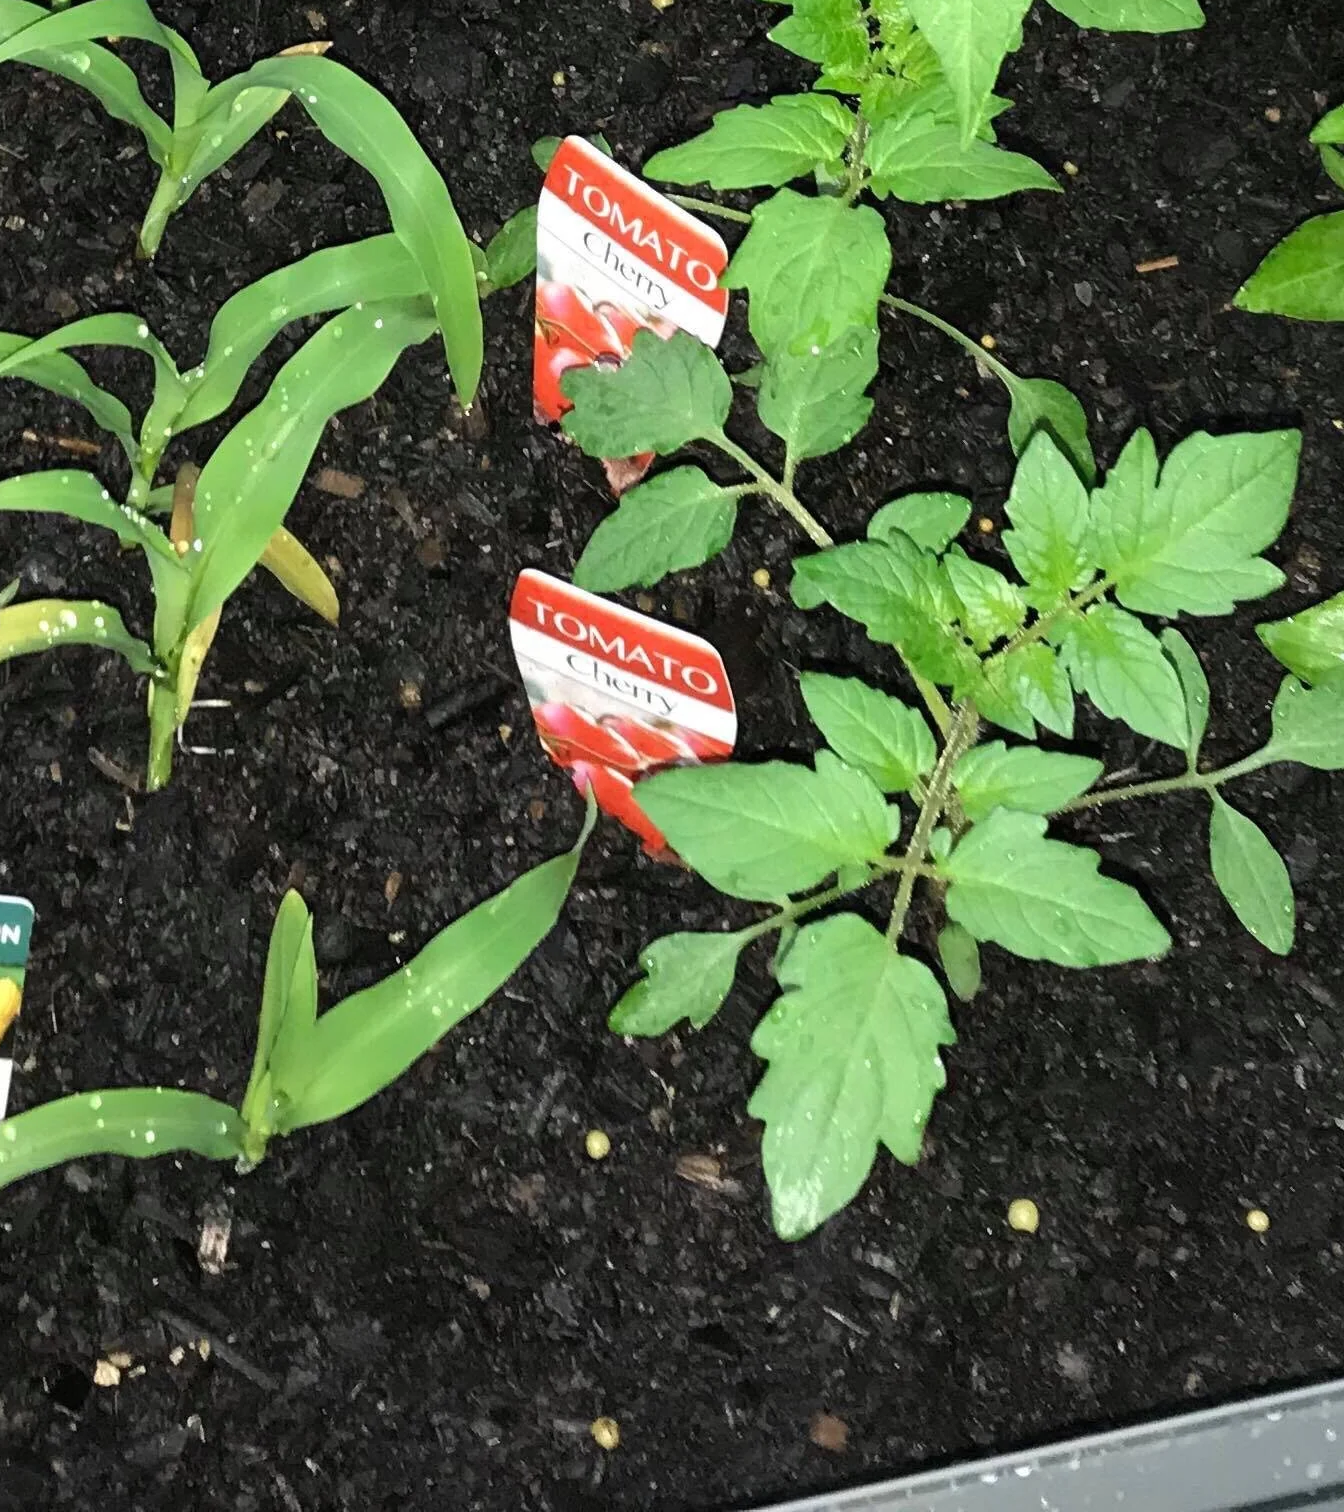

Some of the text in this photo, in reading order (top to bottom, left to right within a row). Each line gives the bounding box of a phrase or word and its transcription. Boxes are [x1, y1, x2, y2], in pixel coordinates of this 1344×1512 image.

[563, 164, 718, 292] TOMATO
[582, 231, 674, 310] Cherry
[526, 596, 718, 695] TOMATO
[566, 653, 678, 716] Cherry
